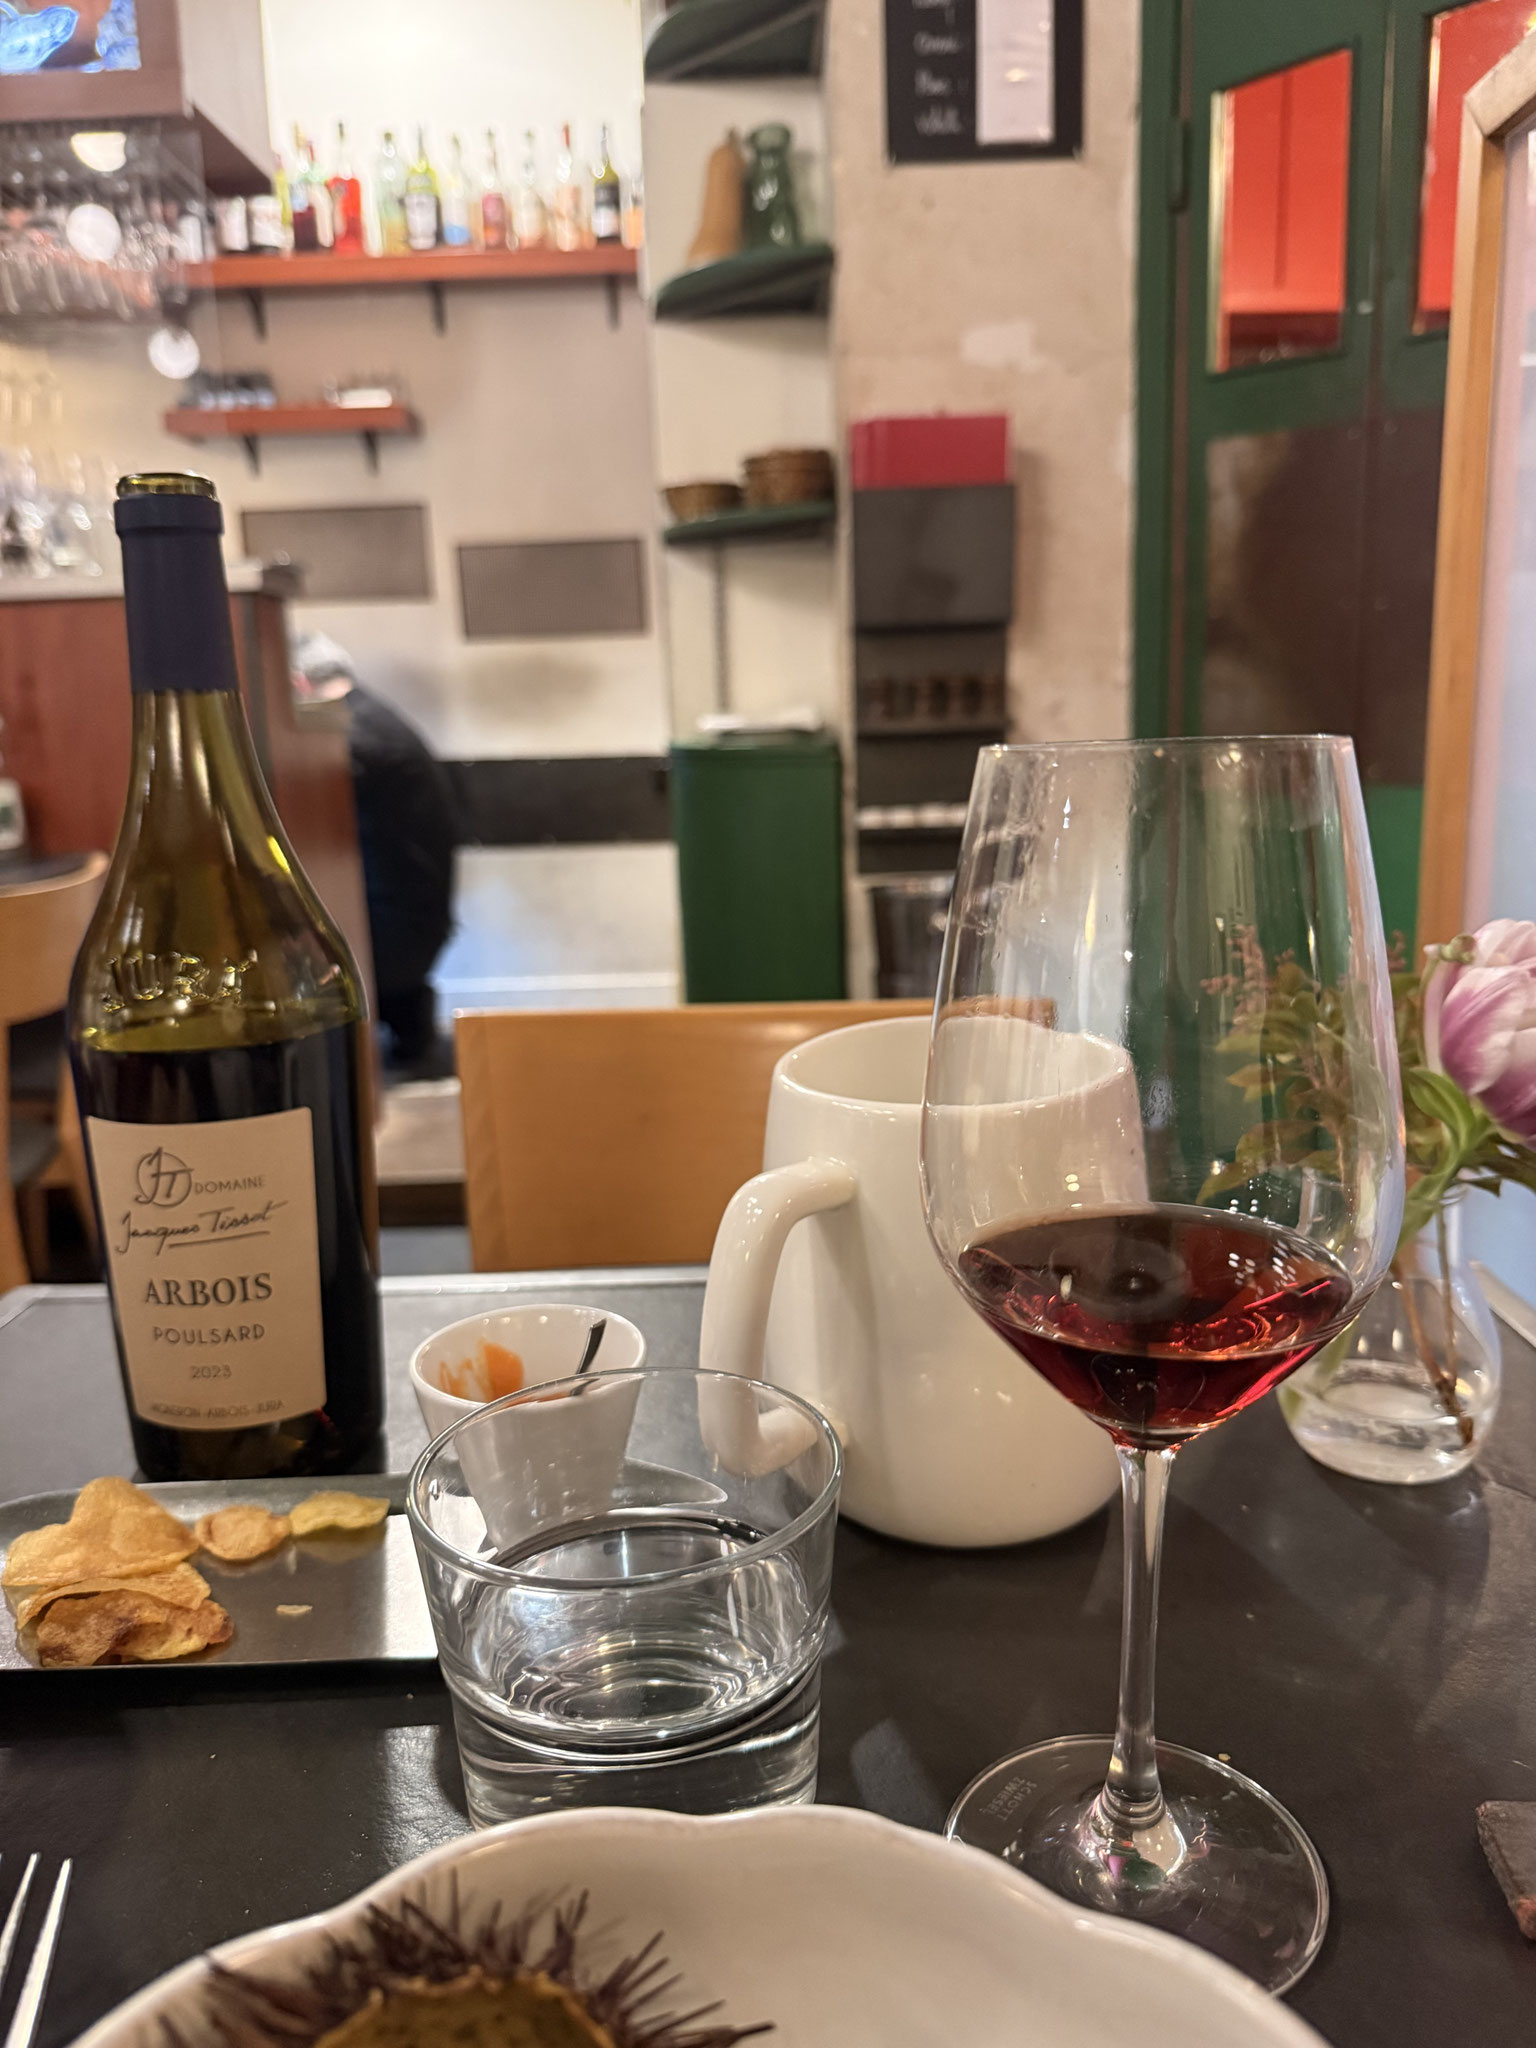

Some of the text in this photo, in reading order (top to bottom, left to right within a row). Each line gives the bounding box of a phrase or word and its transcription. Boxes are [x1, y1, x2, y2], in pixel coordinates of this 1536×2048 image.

[195, 1175, 266, 1196] DOMAINE
[115, 1200, 288, 1257] Jacques Tissot
[145, 1272, 273, 1307] ARBOIS
[154, 1323, 265, 1344] POULSARD
[190, 1364, 232, 1379] 2023
[980, 1776, 1025, 1814] ZWIESEL
[997, 1780, 1037, 1821] SCHOTT
